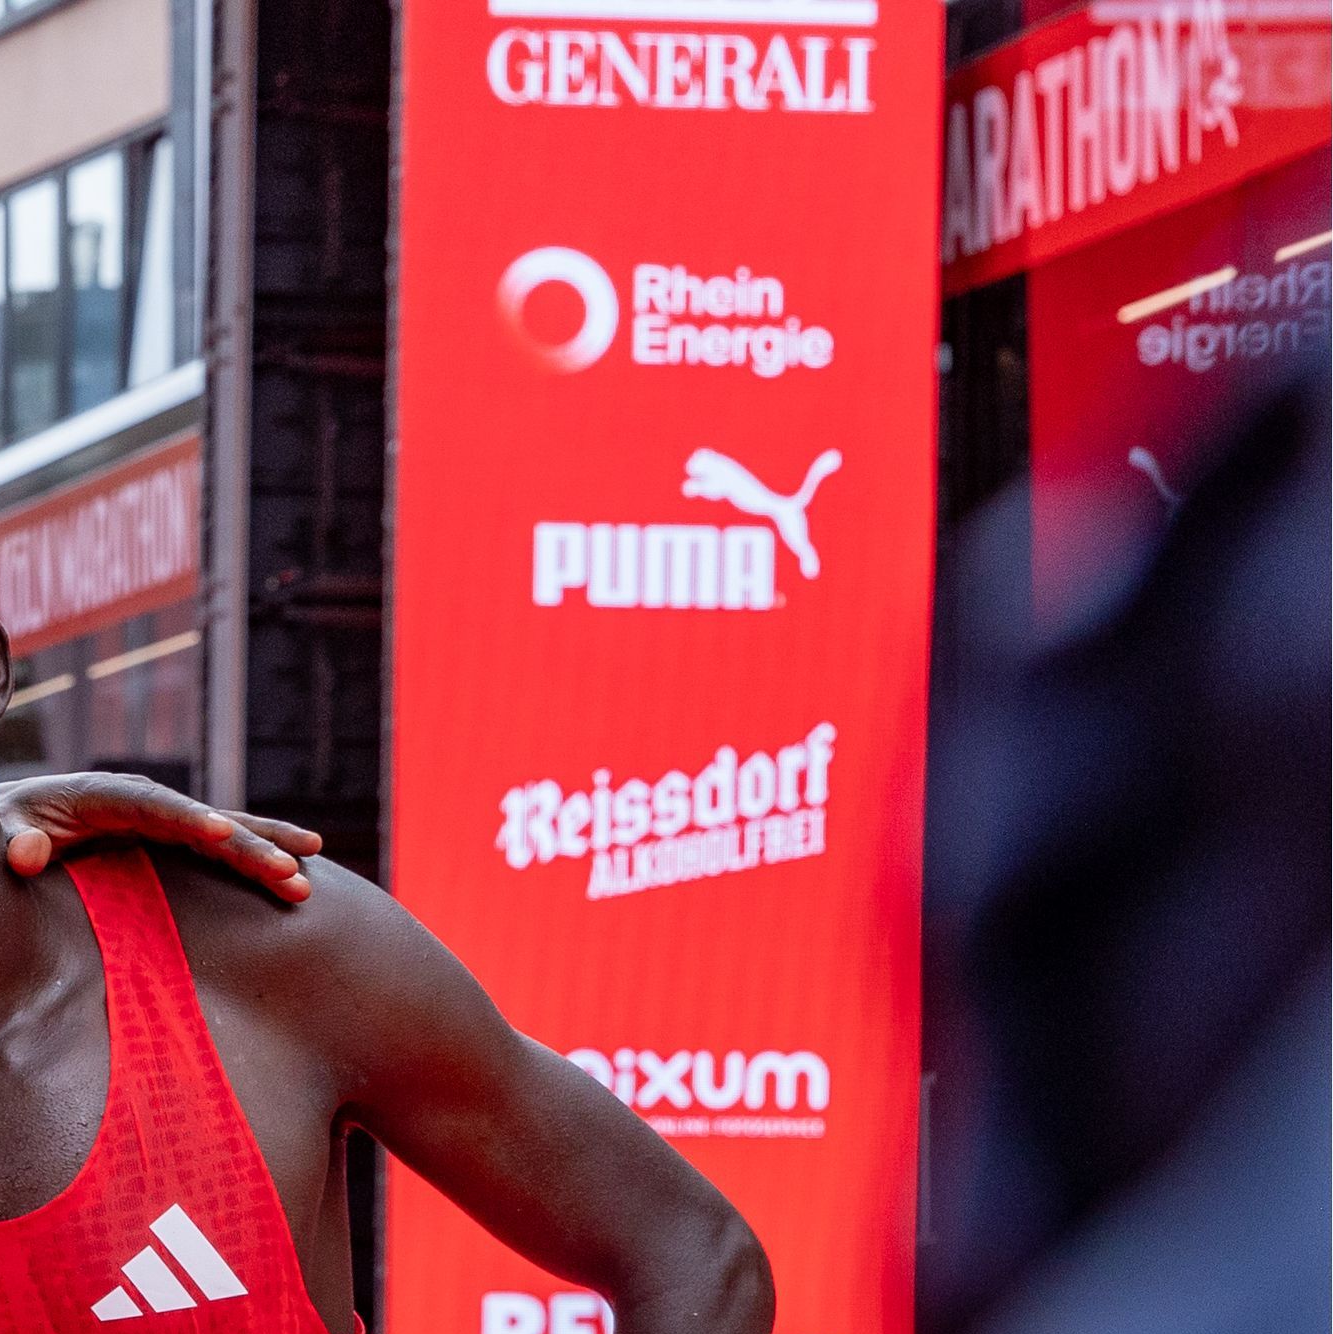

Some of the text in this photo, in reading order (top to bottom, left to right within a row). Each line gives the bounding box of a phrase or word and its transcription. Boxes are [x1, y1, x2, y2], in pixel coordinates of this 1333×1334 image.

[486, 28, 875, 113] GENERALI
[633, 263, 784, 317] Rhein
[633, 316, 833, 377] Energie
[533, 522, 775, 610] PUMA
[496, 721, 836, 869] Reissdorf
